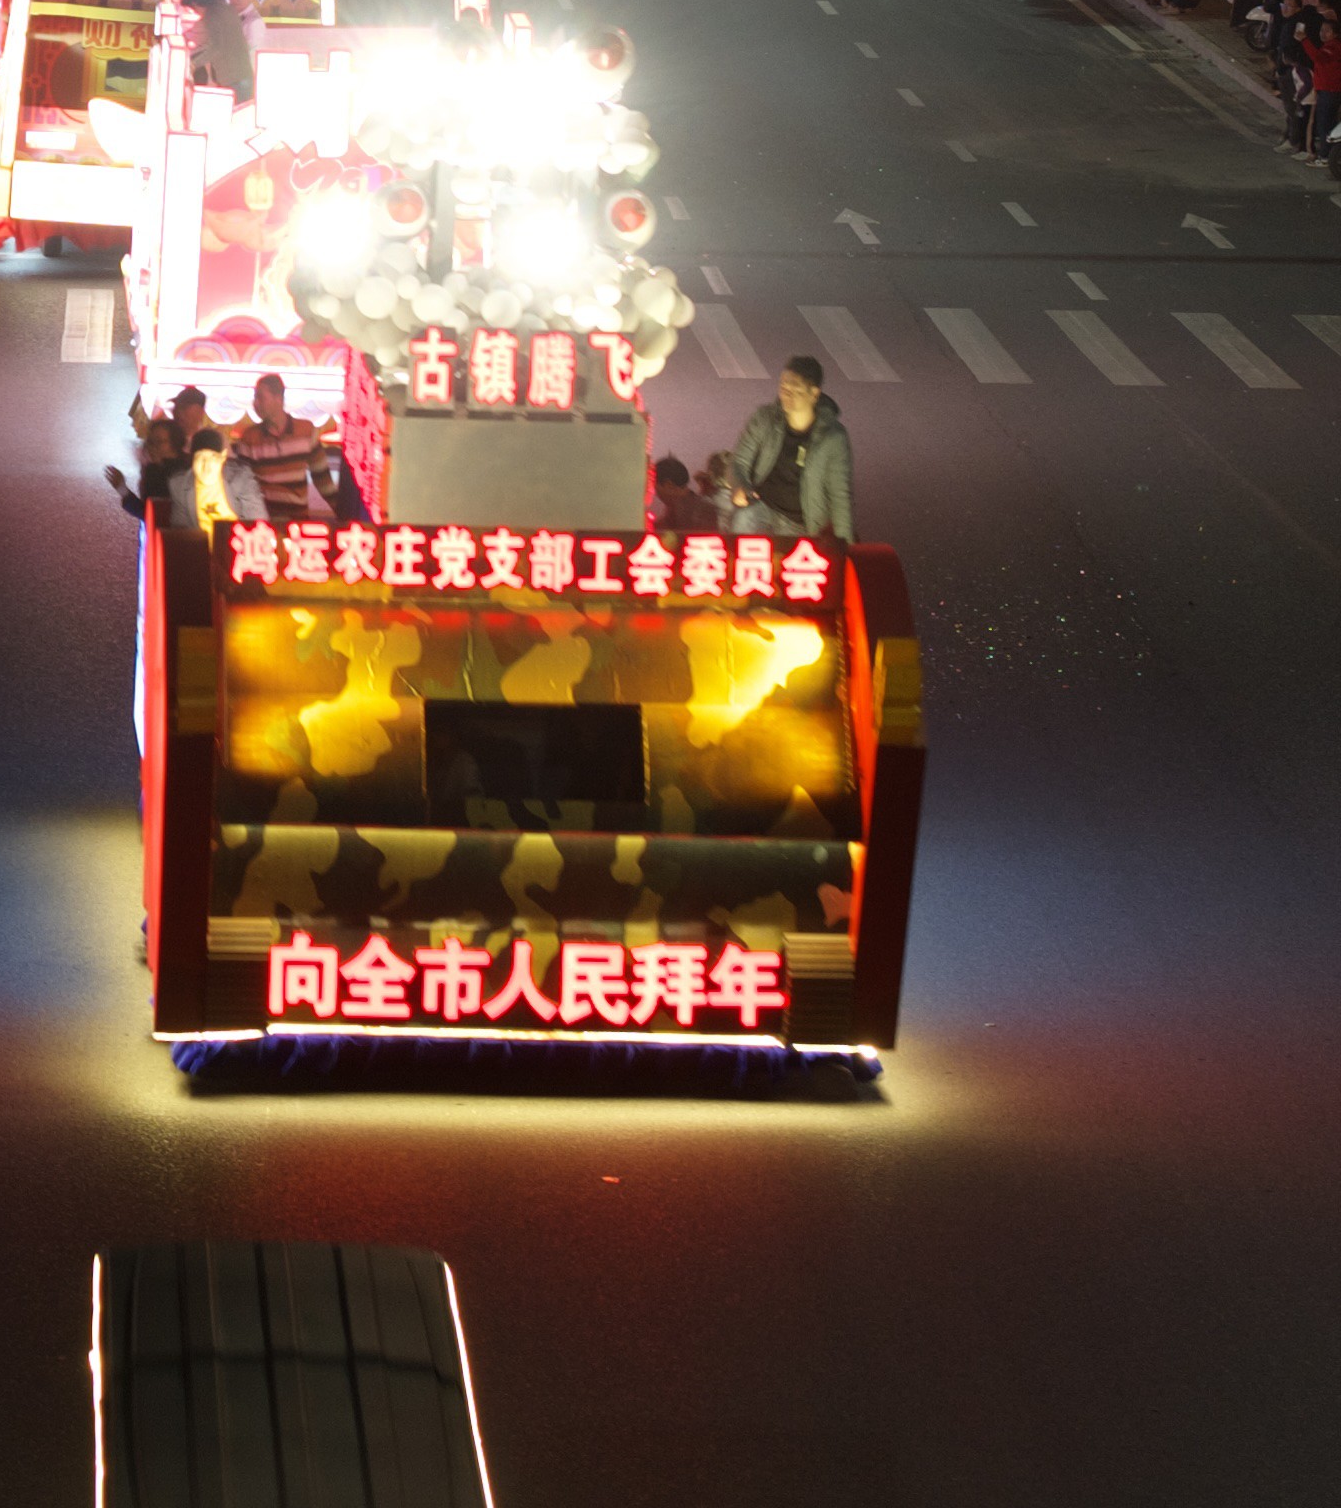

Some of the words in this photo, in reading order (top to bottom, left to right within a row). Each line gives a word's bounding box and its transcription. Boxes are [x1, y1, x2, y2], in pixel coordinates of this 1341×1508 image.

[408, 326, 637, 410] 古镇腾飞
[230, 520, 830, 602] 鸿运农庄党支部工会委员会
[266, 932, 785, 1028] 向全市人民拜年
